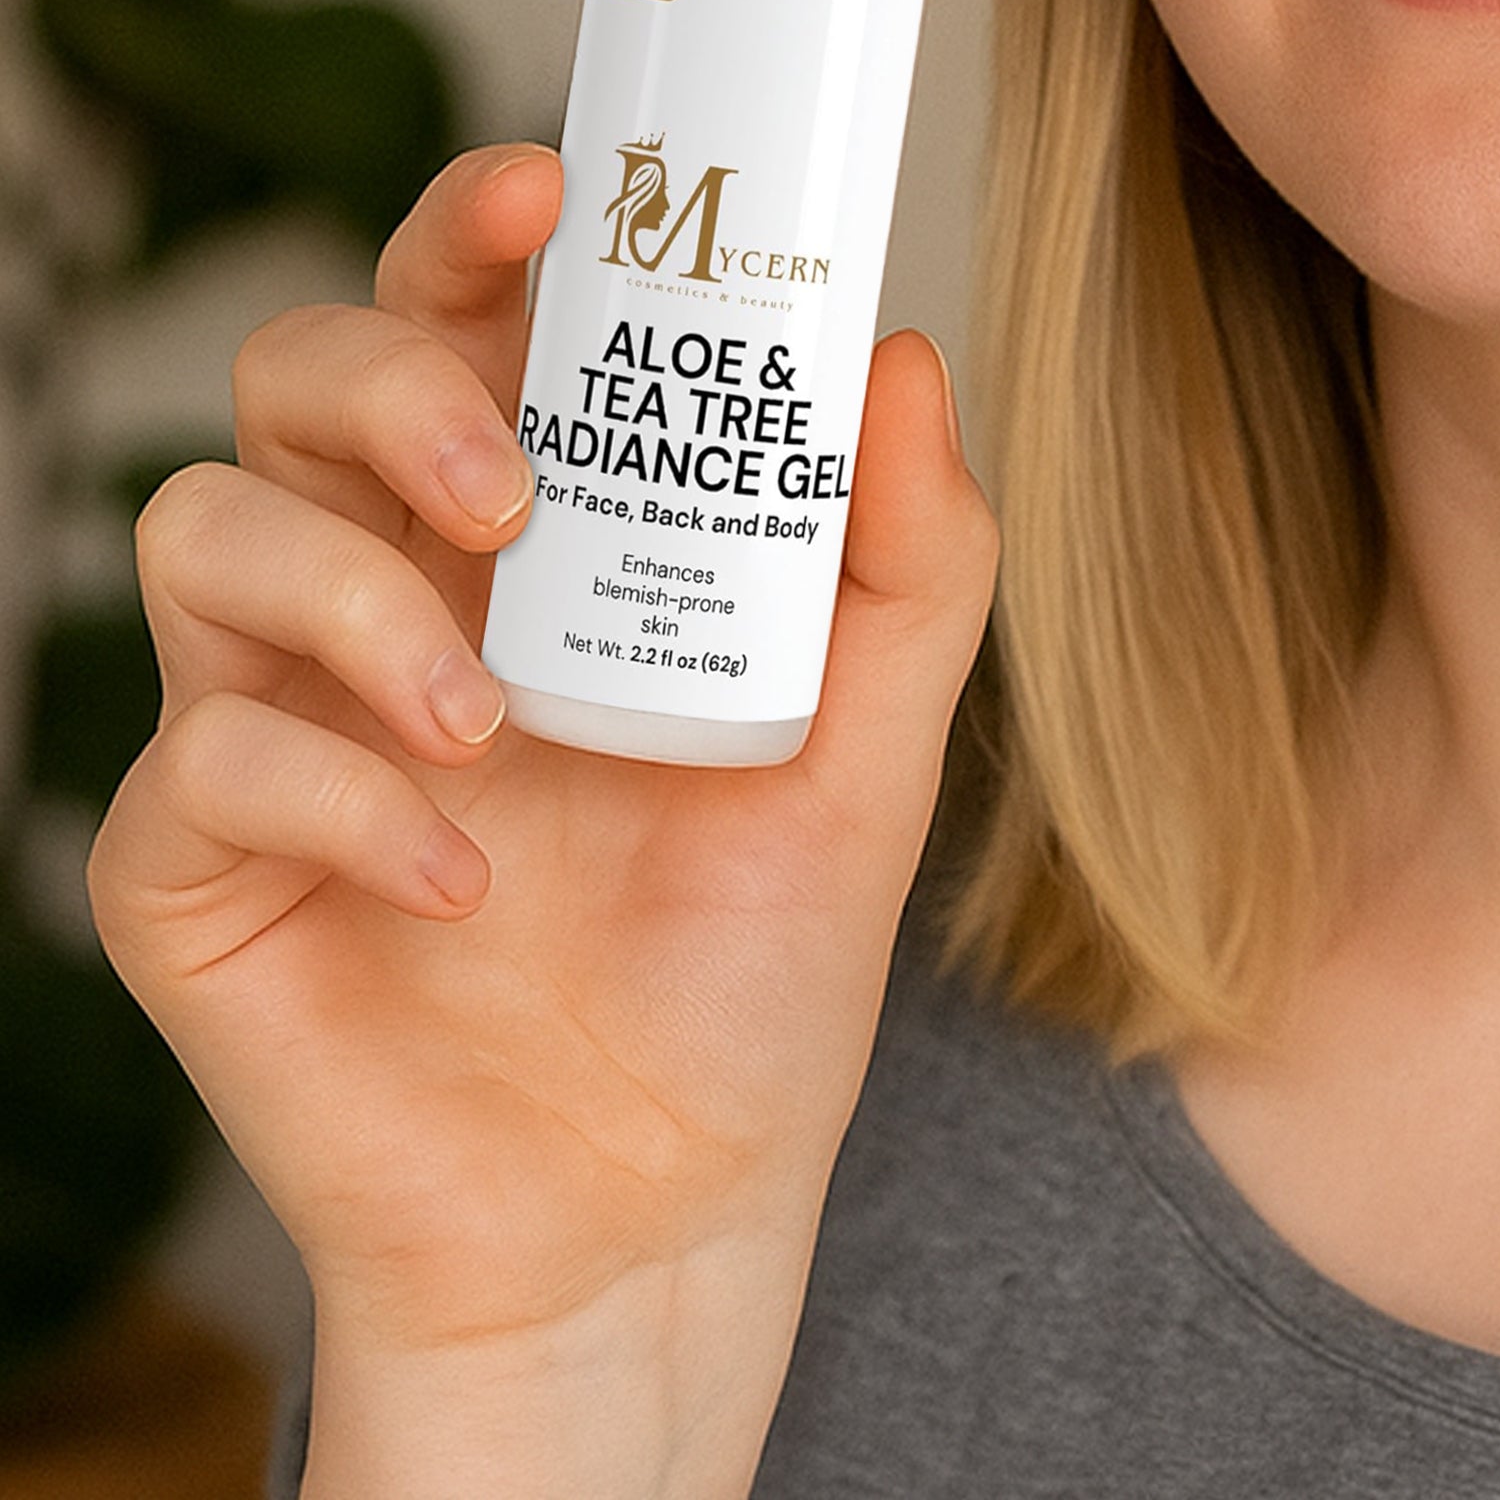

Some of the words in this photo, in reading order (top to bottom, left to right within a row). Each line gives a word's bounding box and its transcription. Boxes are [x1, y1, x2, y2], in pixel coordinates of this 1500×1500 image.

[626, 276, 709, 299] cosmetics
[719, 291, 730, 303] &
[740, 295, 794, 312] beauty
[602, 320, 747, 386] ALOE
[759, 345, 797, 391] &
[579, 366, 668, 430] TEA
[689, 388, 812, 446] TREE
[520, 404, 765, 496] RADIANCE
[777, 454, 850, 500] GEL
[535, 474, 569, 504] For
[572, 485, 635, 524] Face,
[641, 500, 705, 531] Back
[712, 513, 759, 537] and
[764, 515, 819, 544] Body
[621, 553, 715, 585] Enhances
[593, 576, 735, 615] blemish-prone
[640, 615, 679, 637] skin
[563, 632, 592, 654] Net
[598, 639, 626, 660] Wt.
[630, 646, 657, 665] 2.2
[661, 650, 673, 667] fl
[677, 656, 697, 670] oz
[701, 652, 748, 678] (62g)
